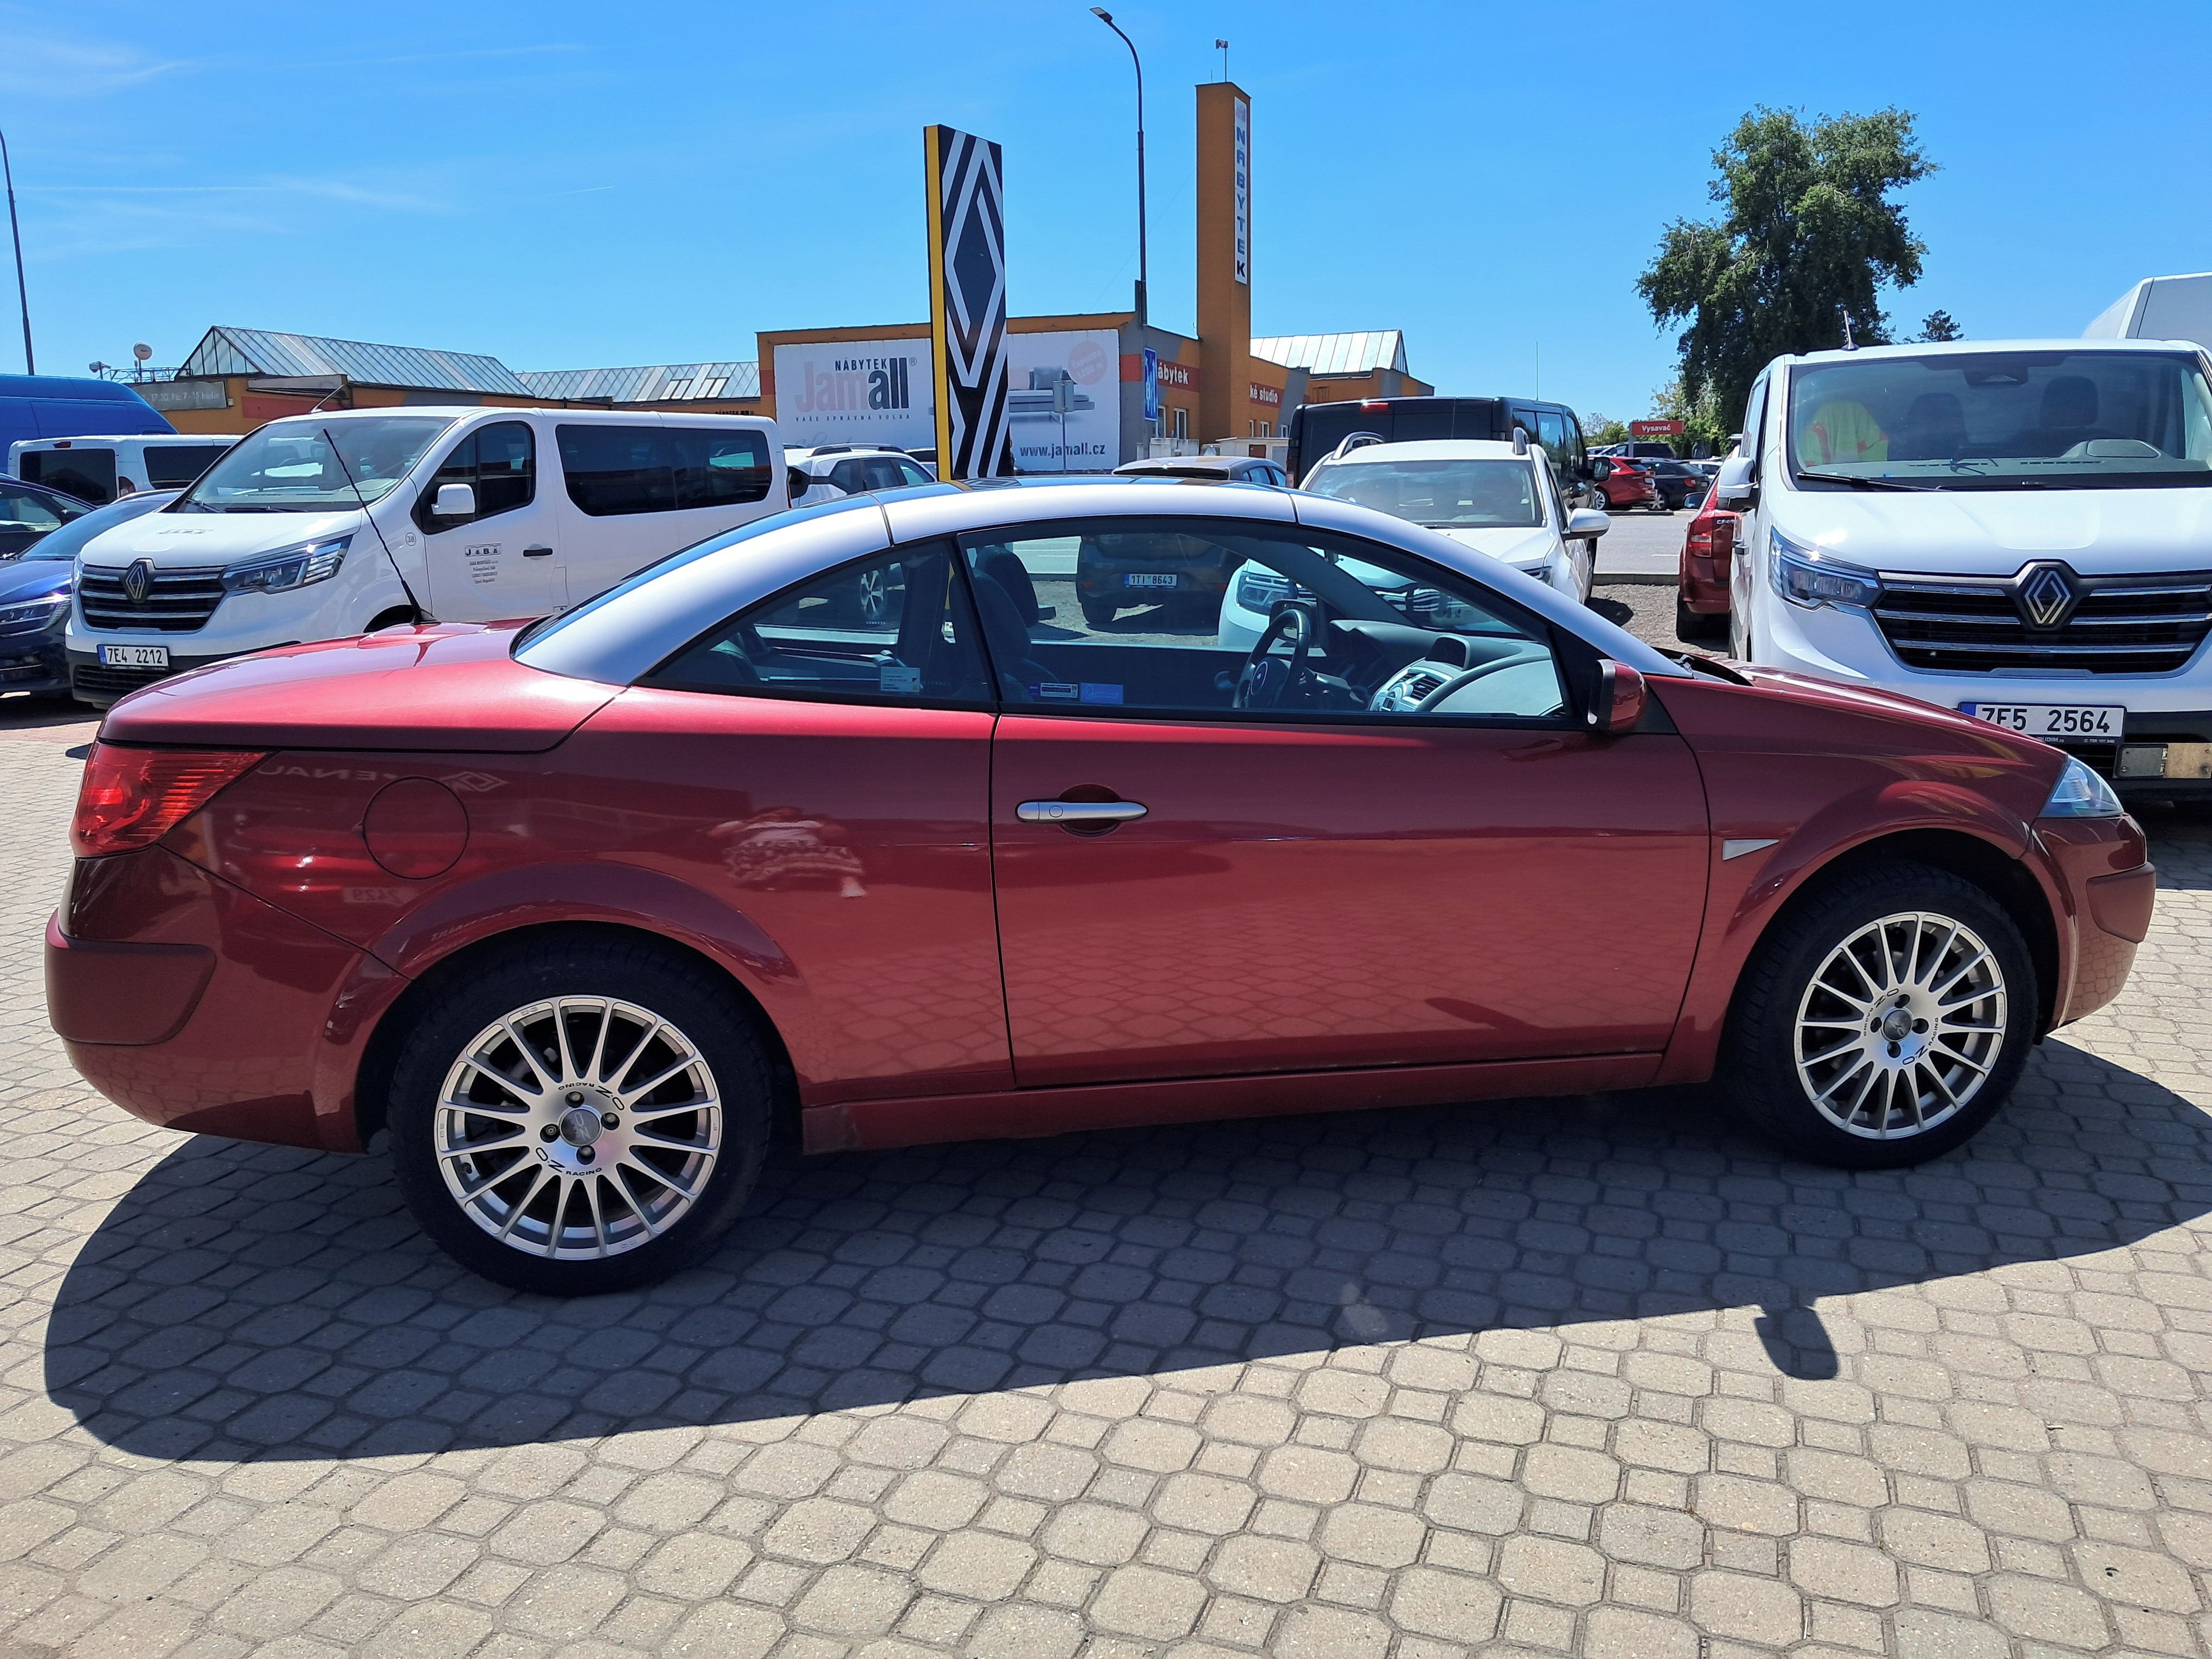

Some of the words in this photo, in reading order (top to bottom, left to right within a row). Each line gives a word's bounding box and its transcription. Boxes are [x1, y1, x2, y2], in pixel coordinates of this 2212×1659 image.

[1237, 126, 1245, 278] NÁBYTEK
[835, 357, 888, 371] NÁBYTEK
[1158, 362, 1188, 385] ábytek
[1250, 384, 1258, 400] ké
[1259, 387, 1278, 404] studio
[1641, 423, 1671, 433] Vysavač
[1019, 442, 1106, 459] www.jamall.cz
[1131, 575, 1145, 584] 1TI
[1152, 575, 1173, 584] 8643
[107, 647, 127, 663] 7E4
[135, 648, 163, 664] 2212
[2047, 709, 2111, 734] 2564
[565, 1167, 602, 1176] RACING
